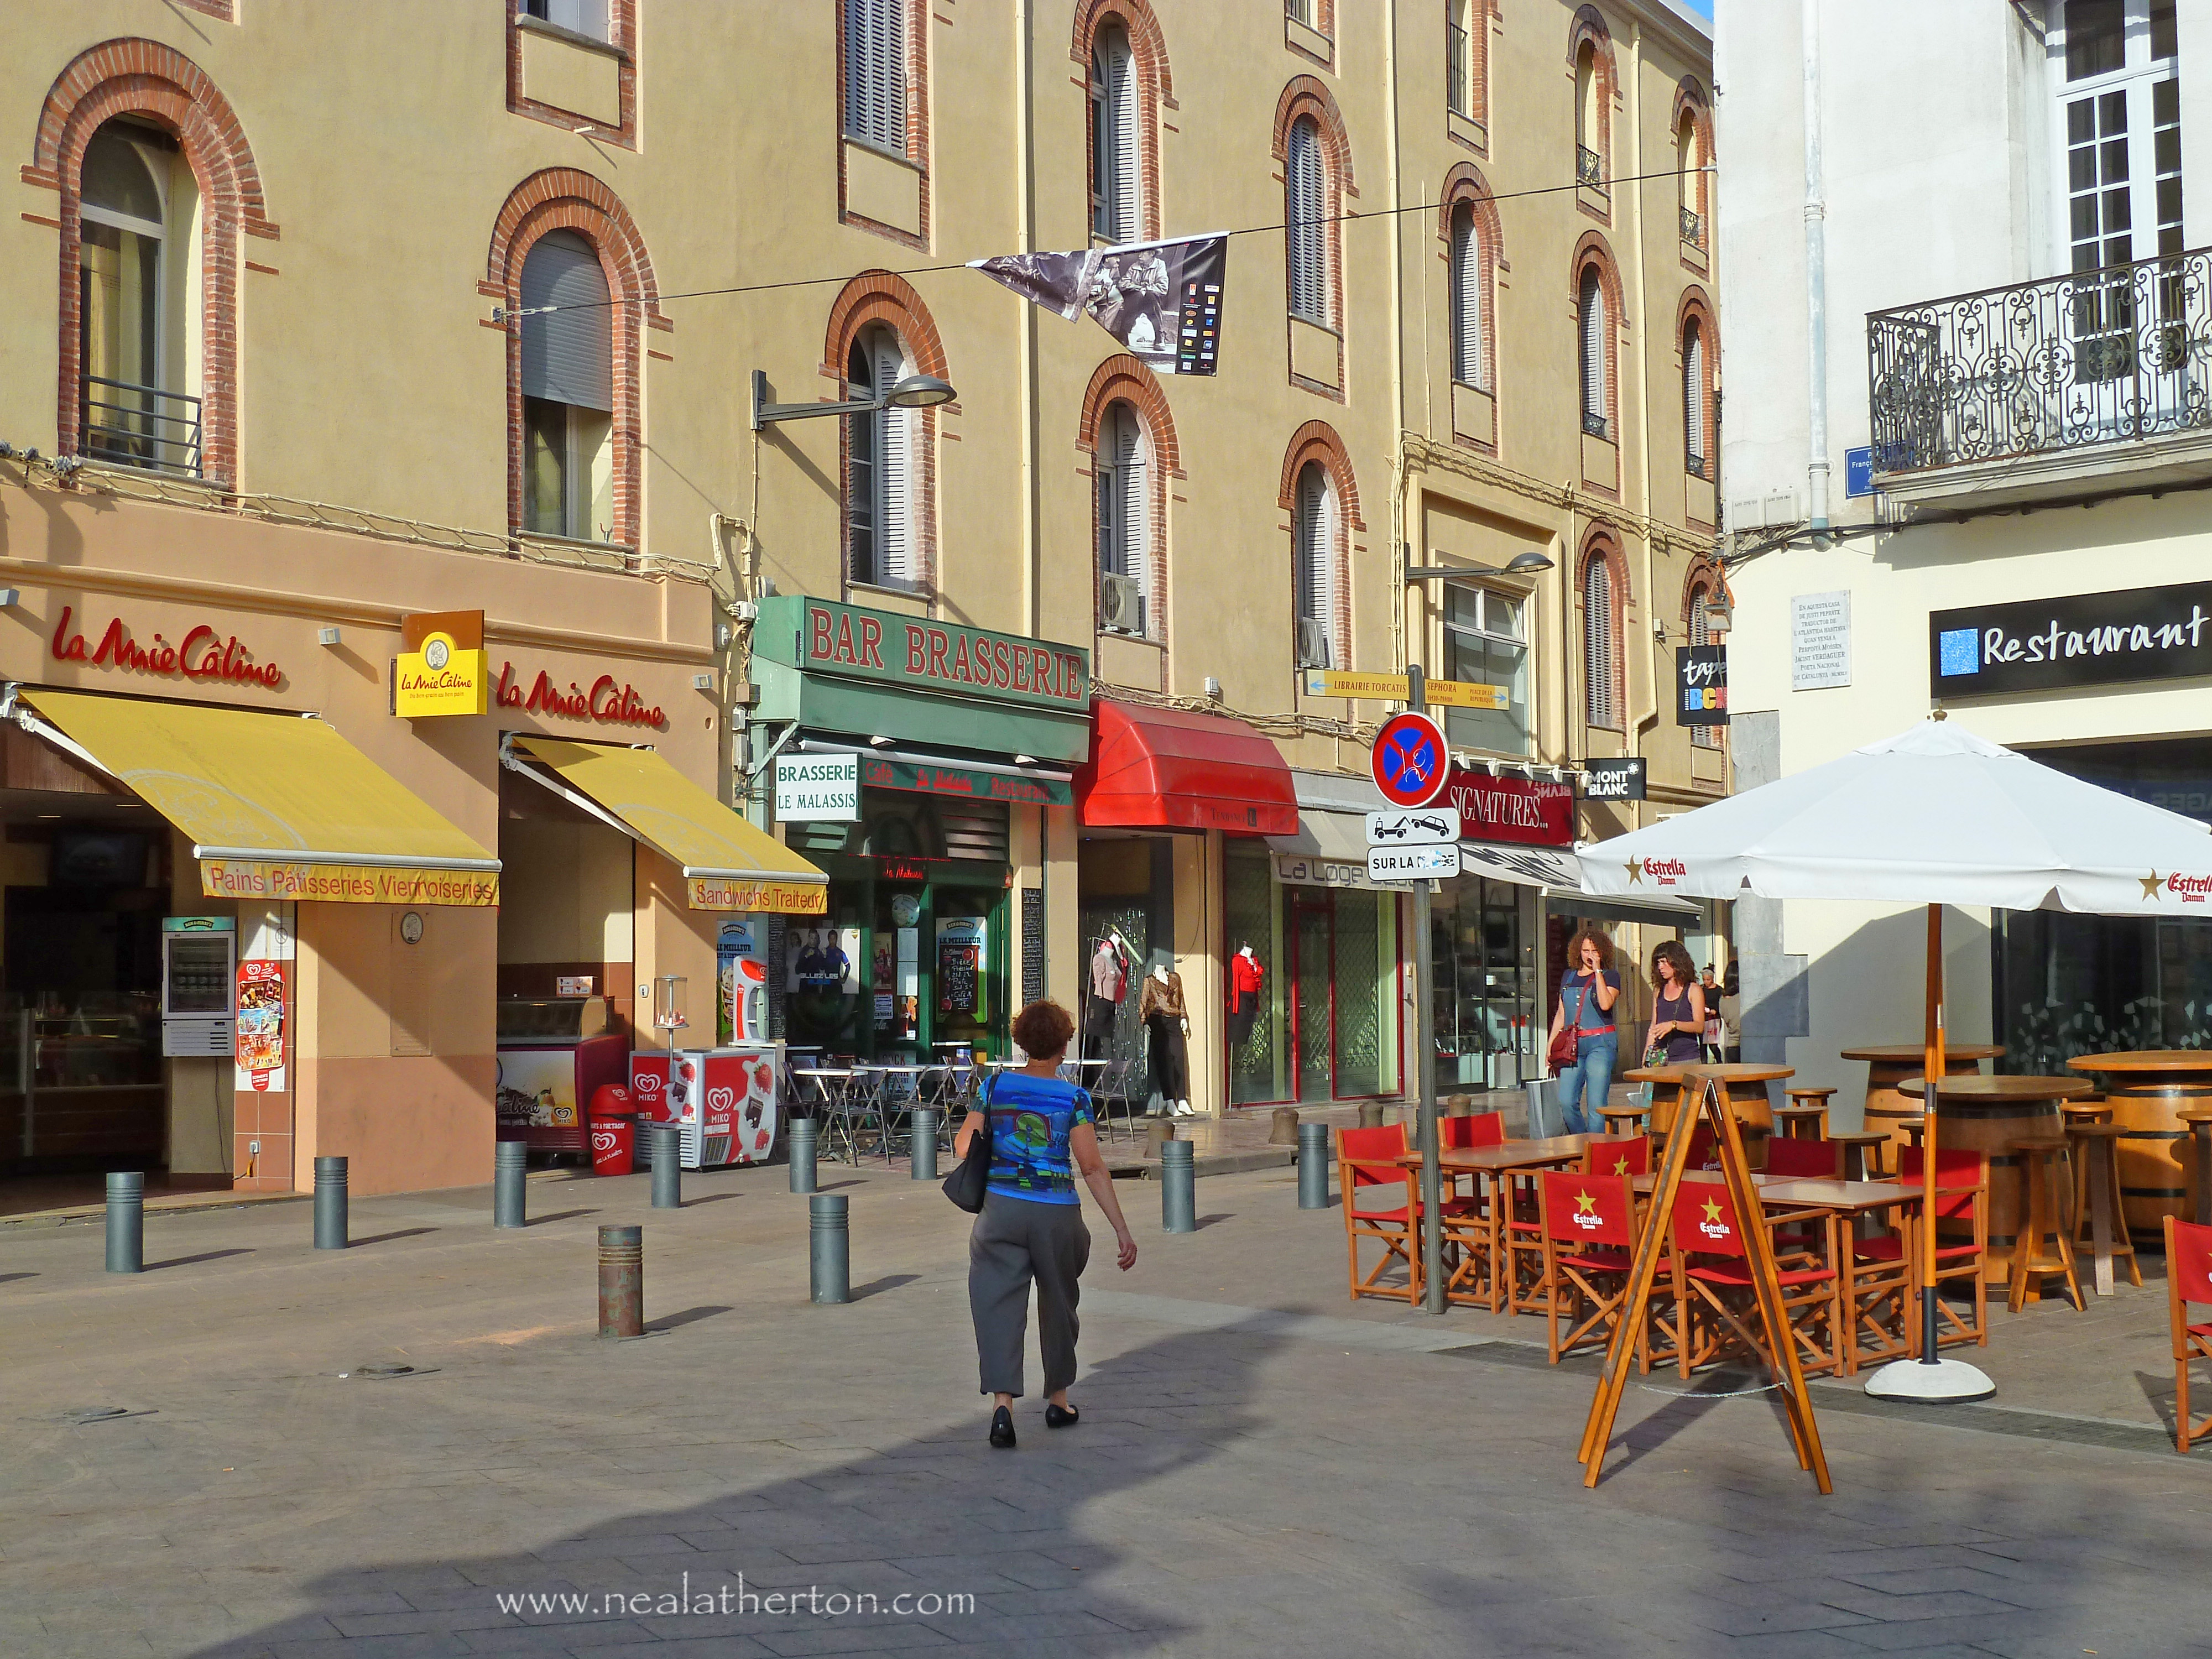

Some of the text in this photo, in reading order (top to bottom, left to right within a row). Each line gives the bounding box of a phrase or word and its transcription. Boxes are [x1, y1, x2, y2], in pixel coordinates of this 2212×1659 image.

[1984, 605, 2211, 665] Restaurant
[179, 625, 280, 687] Câline
[810, 607, 1083, 701] BAR BRASSERIE
[1812, 652, 1845, 660] VERDAGUER
[440, 671, 472, 688] Câline
[1334, 680, 1406, 693] LIBRAIRIE TORCATIS
[1427, 682, 1457, 693] SEPHORA
[589, 675, 664, 727] Câline
[778, 765, 855, 782] BRASSERIE
[865, 761, 893, 784] Café
[991, 777, 1050, 801] Restaurant
[1589, 771, 1628, 783] MONT
[1588, 782, 1628, 796] BLANC
[778, 793, 855, 809] LE MALASSIS
[1373, 858, 1396, 869] SUR
[1400, 857, 1414, 869] LA
[1644, 857, 1687, 876] Estrella
[1279, 857, 1306, 880] La
[1312, 859, 1363, 886] Loge
[211, 867, 493, 900] Pains Pâtisseries Viennoiseries
[1657, 875, 1676, 885] Damm
[697, 884, 821, 909] Sandwichs Traiteur
[2182, 892, 2205, 902] Damm
[711, 1113, 729, 1124] MIKO
[1573, 1213, 1603, 1225] Estrella
[1699, 1222, 1730, 1234] Estrella
